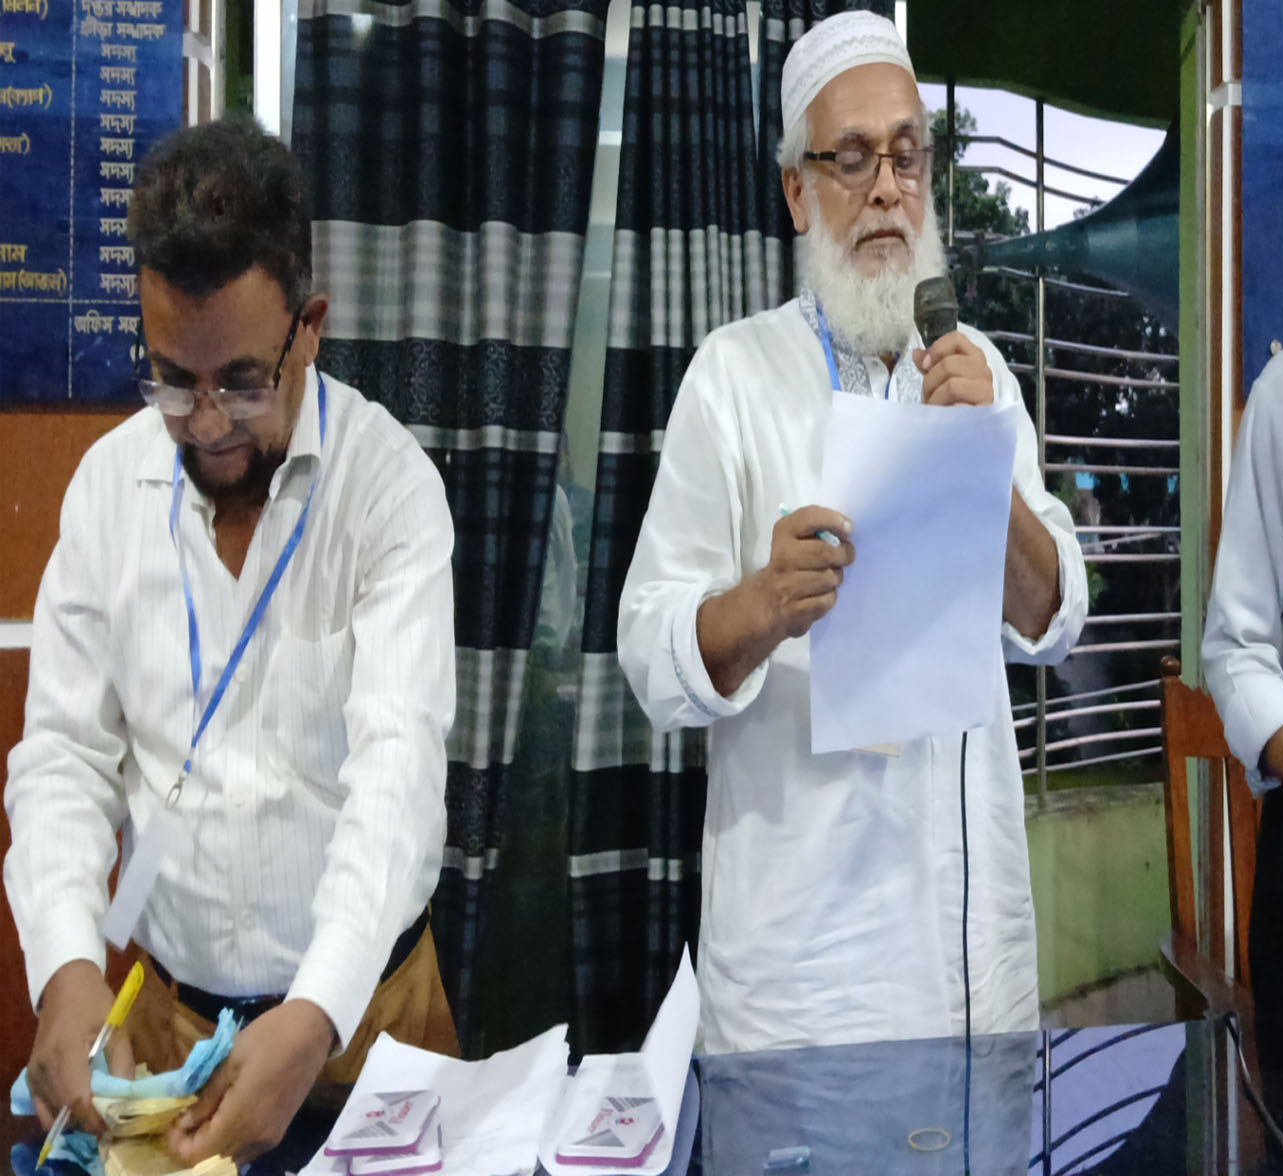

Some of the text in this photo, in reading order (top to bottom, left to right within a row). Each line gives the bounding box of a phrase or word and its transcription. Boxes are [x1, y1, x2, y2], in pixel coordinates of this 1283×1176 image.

[101, 43, 137, 62] সদস্য
[100, 66, 136, 86] সদস্য
[100, 89, 137, 111] সদস্য
[100, 114, 137, 135] সদস্য
[100, 137, 135, 159] সদস্য
[100, 161, 135, 184] সদস্য
[100, 187, 134, 208] সদস
[99, 245, 135, 267] সদস্য
[99, 272, 137, 298] সদস্য
[74, 309, 141, 335] অফিস সহ
